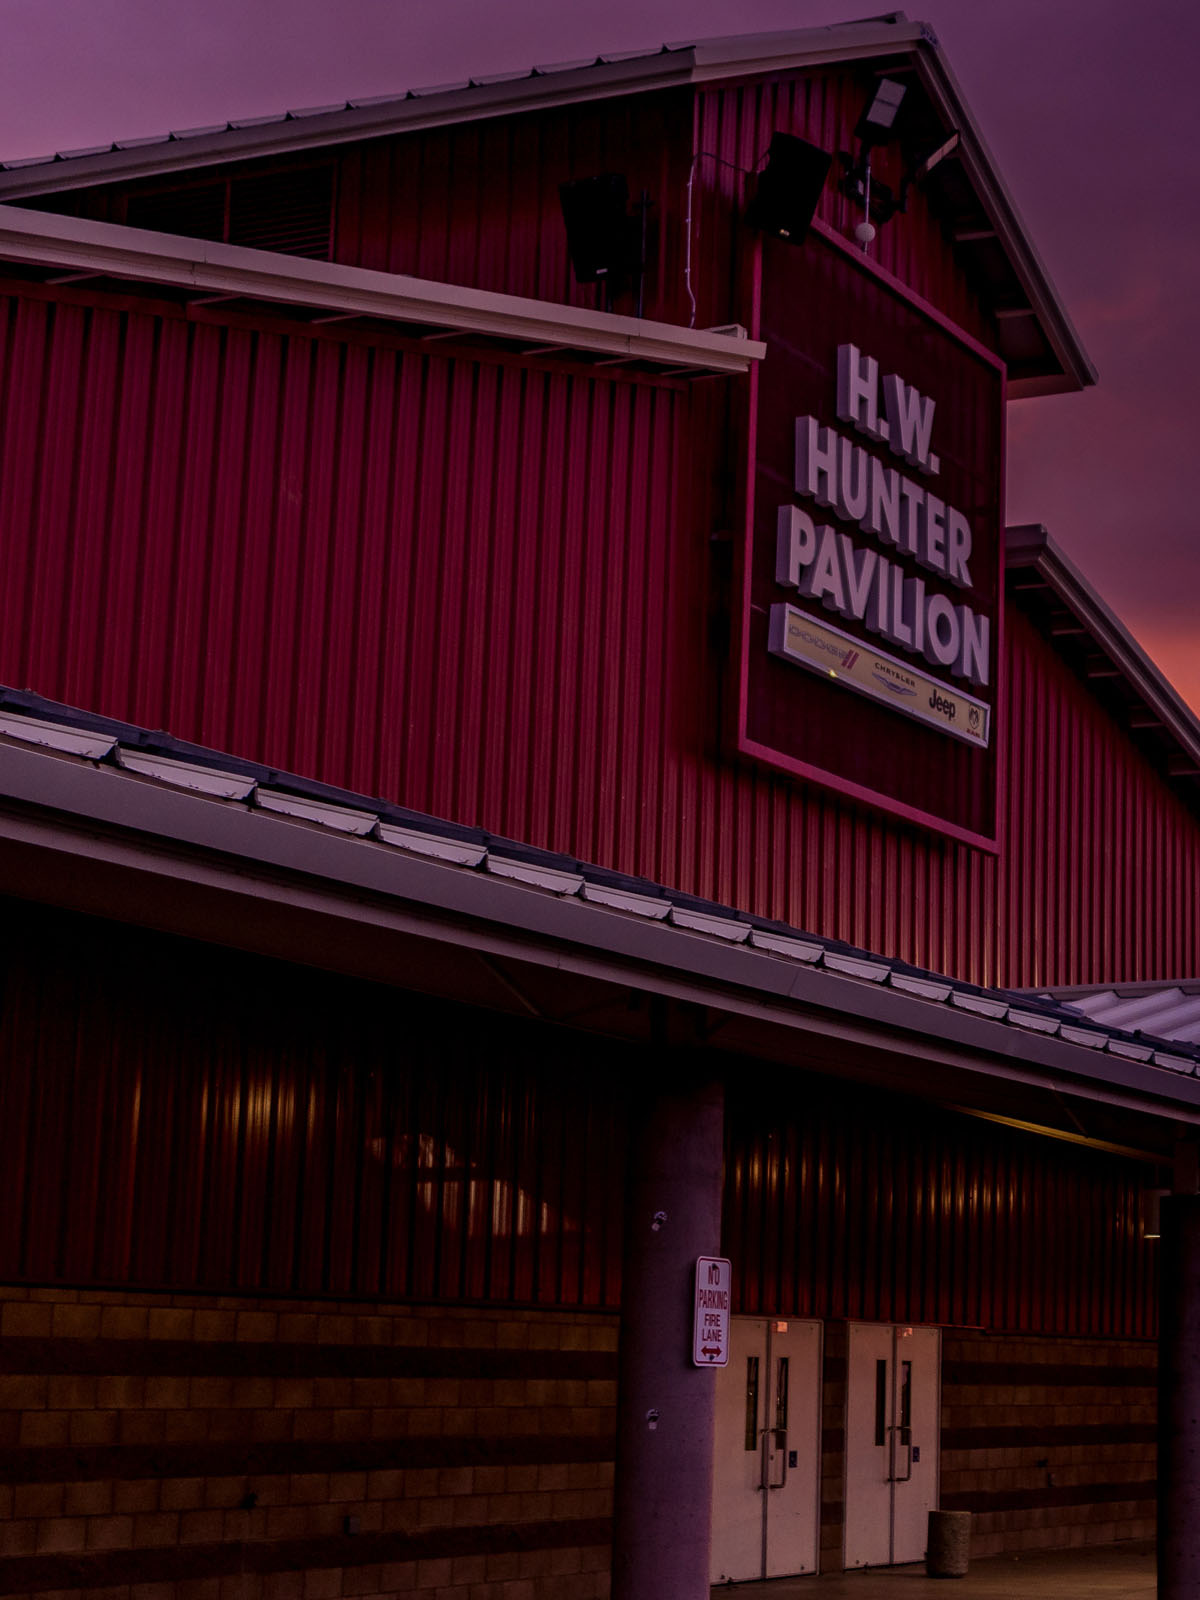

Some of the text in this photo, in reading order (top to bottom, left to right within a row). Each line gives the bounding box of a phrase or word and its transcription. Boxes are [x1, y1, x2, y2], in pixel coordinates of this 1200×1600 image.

[836, 342, 941, 475] H.W.
[794, 414, 974, 588] HUNTER
[775, 504, 990, 687] PAVILION
[874, 662, 916, 687] CHRYSLER
[929, 689, 956, 721] Jeep
[708, 1266, 720, 1285] NO
[699, 1289, 728, 1310] PARKING
[704, 1314, 721, 1327] FIRE
[702, 1328, 722, 1342] LANE
